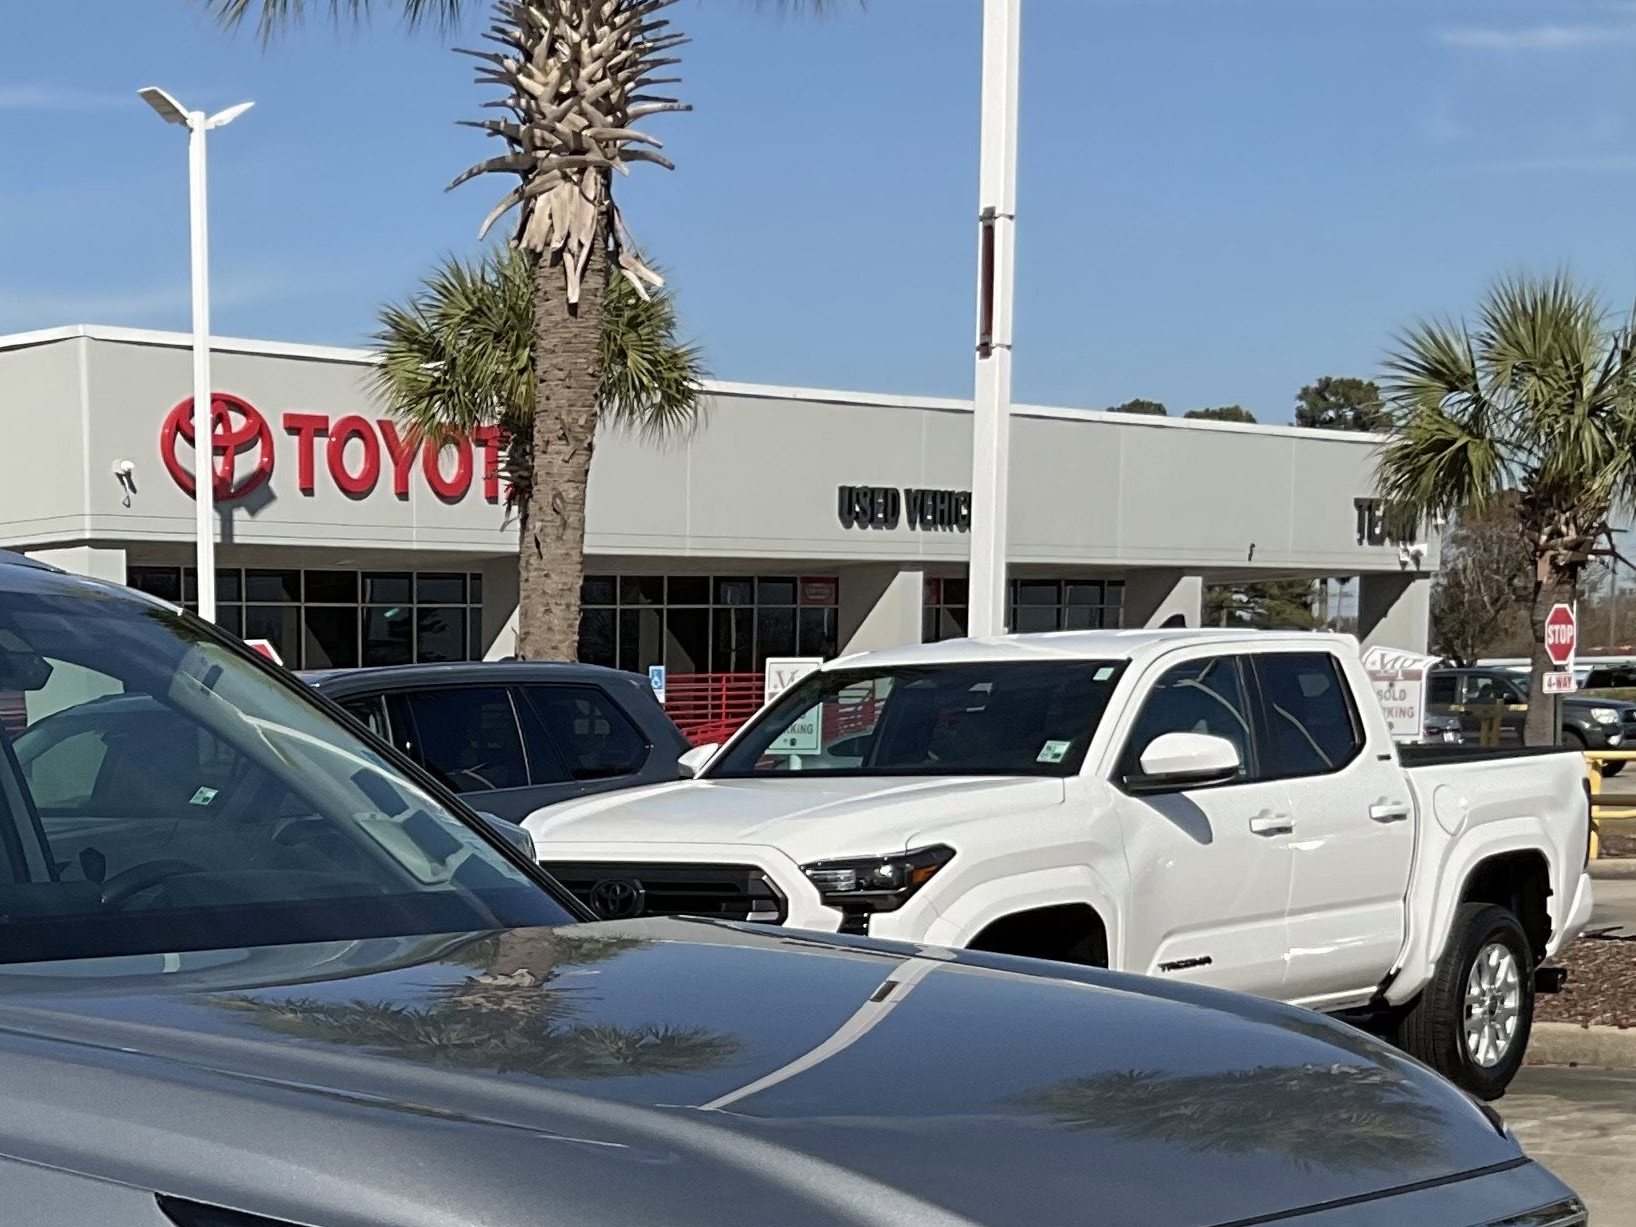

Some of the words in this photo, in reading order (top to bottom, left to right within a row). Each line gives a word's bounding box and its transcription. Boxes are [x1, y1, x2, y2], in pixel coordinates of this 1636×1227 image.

[283, 413, 512, 503] TOYOT
[838, 486, 900, 530] USED
[904, 489, 972, 533] VEHIC
[1548, 624, 1574, 645] STOP
[1547, 676, 1572, 689] 4-WAY
[1377, 689, 1406, 701] SOLD
